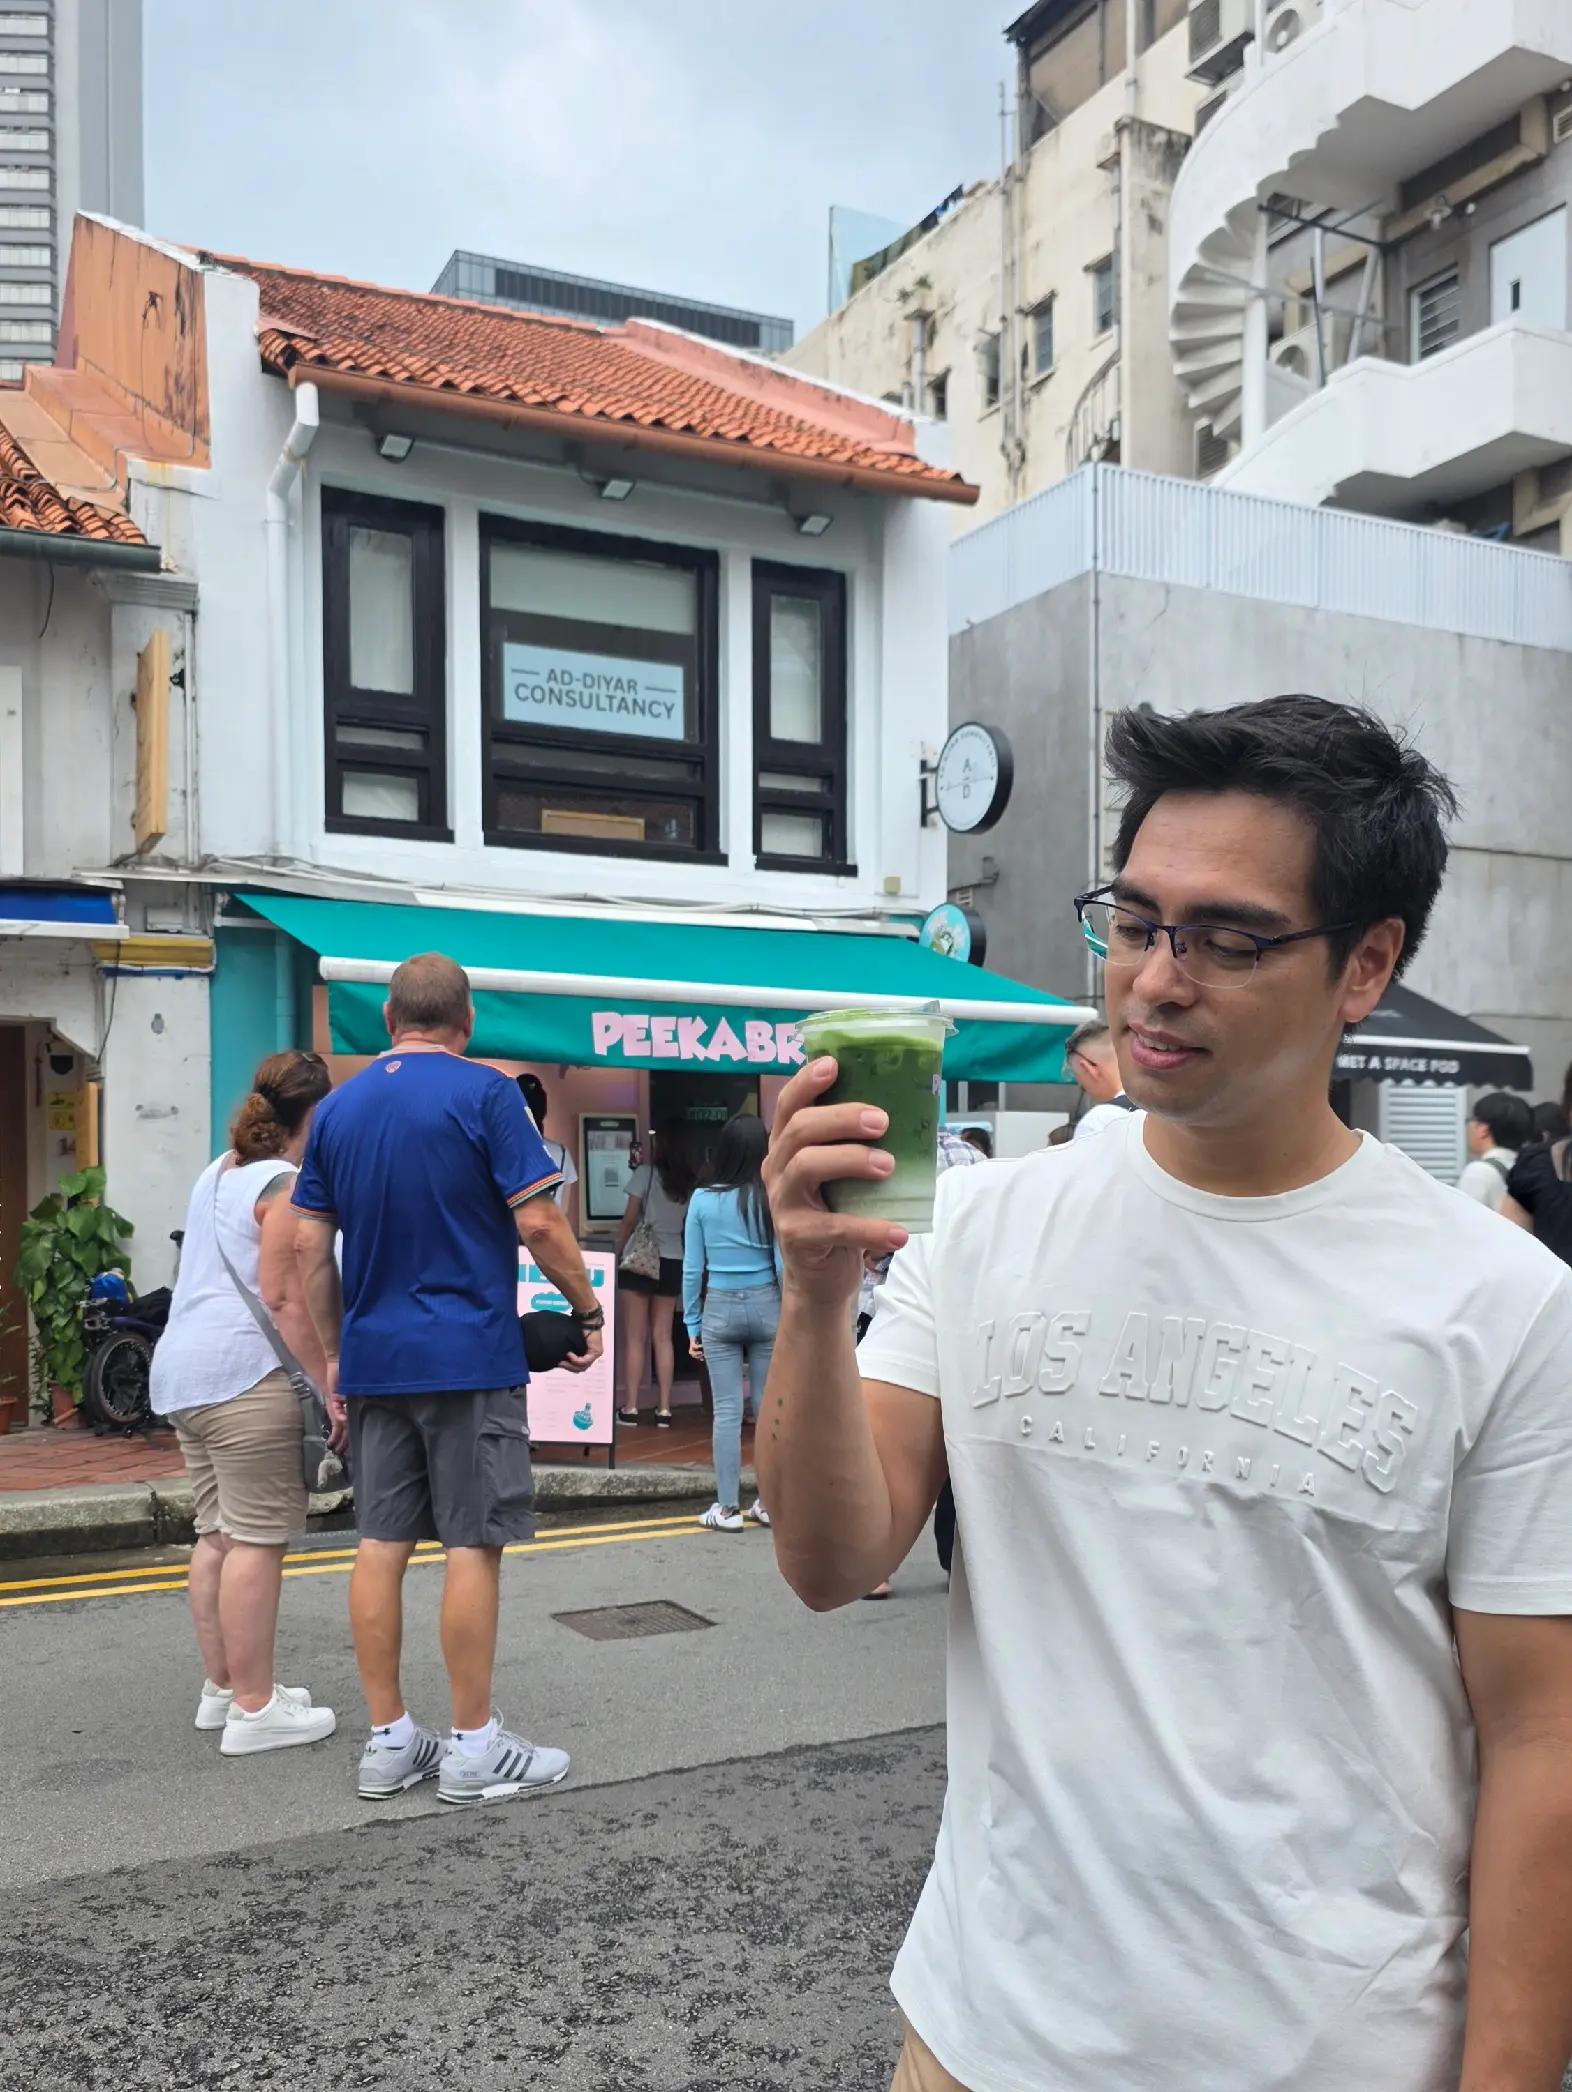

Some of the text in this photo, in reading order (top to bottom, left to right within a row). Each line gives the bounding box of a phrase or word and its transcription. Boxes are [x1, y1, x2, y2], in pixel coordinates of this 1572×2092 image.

[546, 668, 637, 695] AD-DIYAR
[514, 683, 675, 719] CONSULTANCY
[1384, 1056, 1428, 1072] SPACE
[972, 1310, 1419, 1494] LOS ANGELES
[1018, 1415, 1317, 1496] CALIFORNIA
